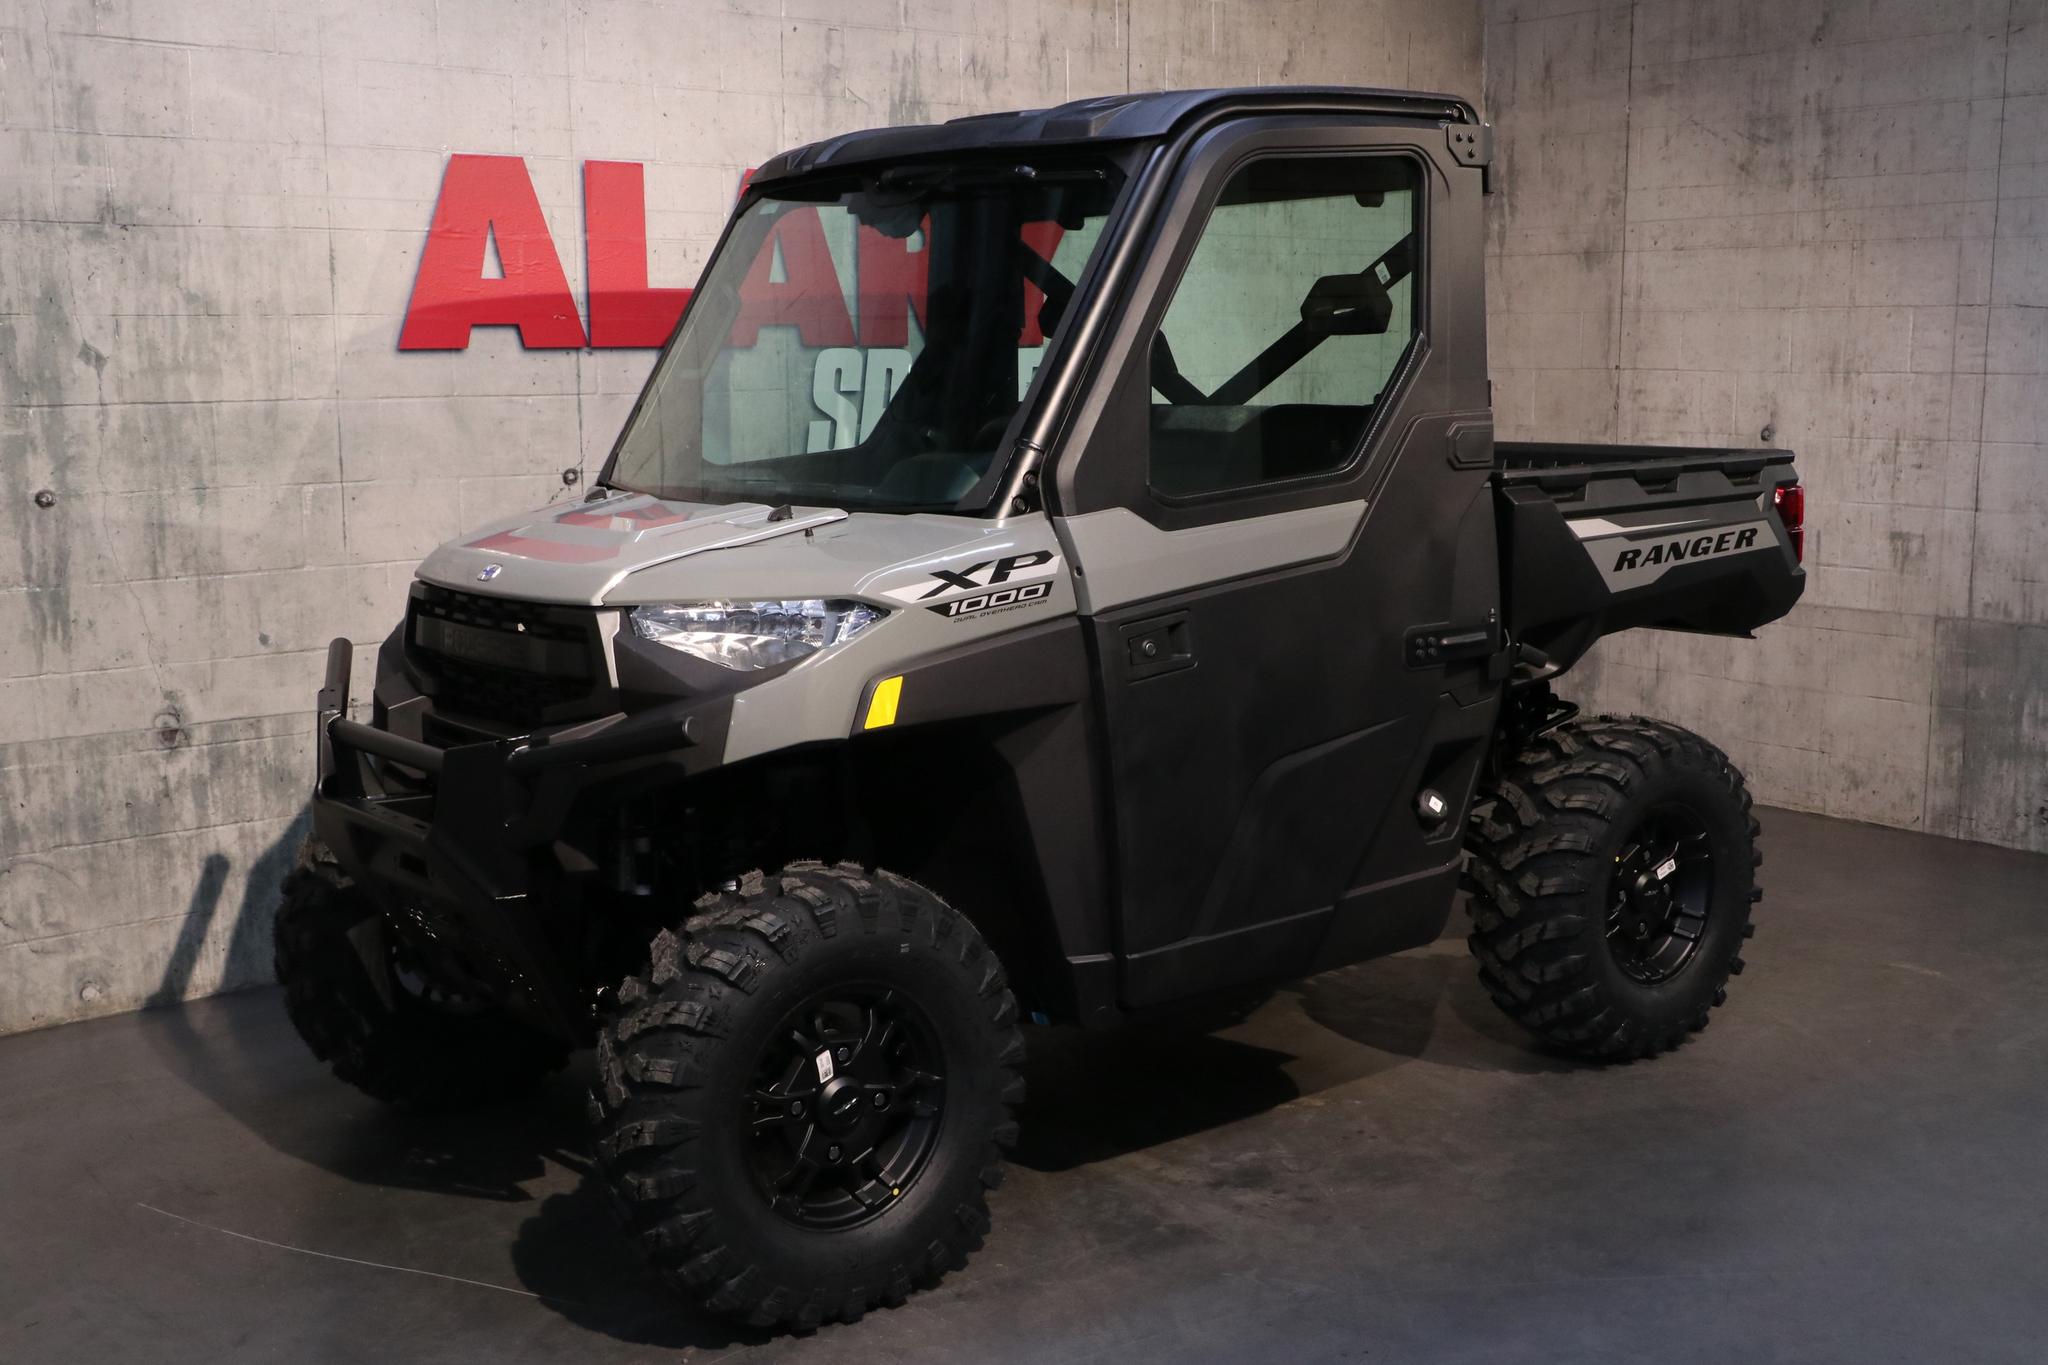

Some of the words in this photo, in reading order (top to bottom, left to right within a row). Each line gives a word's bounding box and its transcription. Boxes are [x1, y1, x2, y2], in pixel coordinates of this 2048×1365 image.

[1612, 527, 1759, 573] RANGER
[918, 550, 1055, 600] XP
[948, 583, 1047, 617] 1000
[953, 614, 977, 623] DUAL
[979, 603, 1027, 618] OVERHEAD
[1028, 599, 1048, 607] CAM
